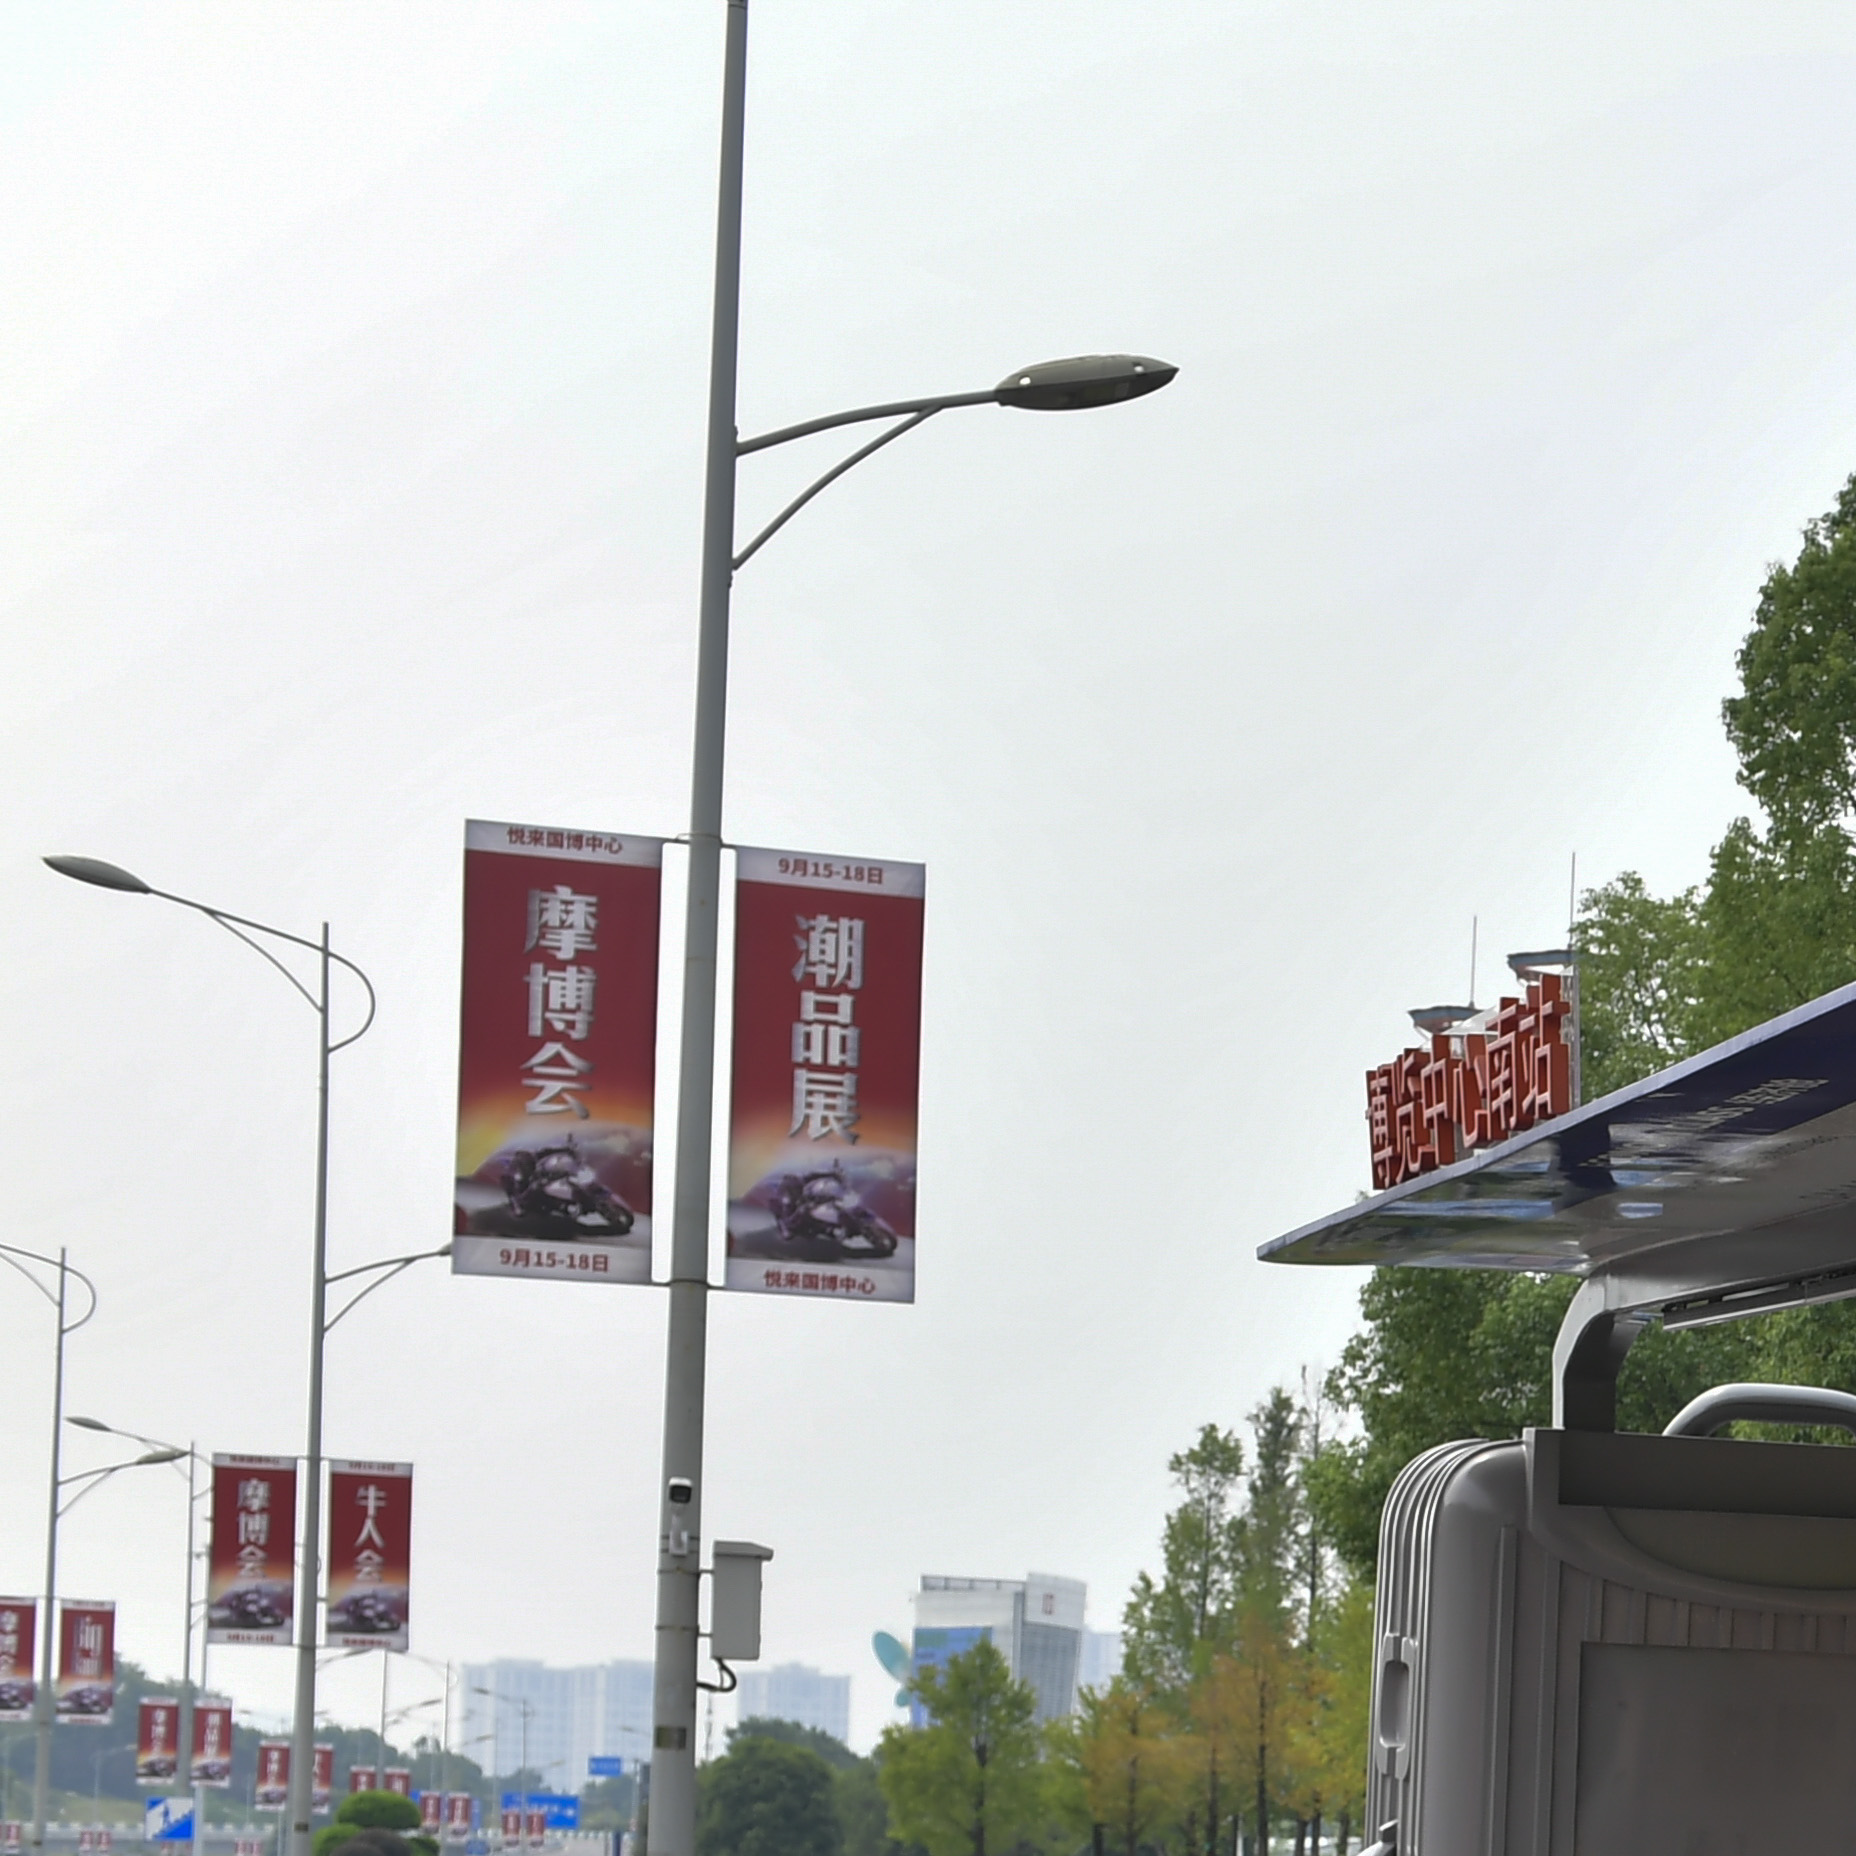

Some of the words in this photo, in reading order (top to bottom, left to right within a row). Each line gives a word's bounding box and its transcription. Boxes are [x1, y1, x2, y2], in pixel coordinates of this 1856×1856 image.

[507, 826, 623, 855] 悦来国博中心
[777, 857, 884, 885] 9月15-18日
[521, 884, 599, 1119] 摩博会
[788, 913, 865, 1146] 潮品展
[1366, 975, 1570, 1190] 博览中心南站
[498, 1247, 609, 1273] 9月15-18日
[763, 1268, 876, 1296] 悦来国博中心
[237, 1477, 271, 1579] 摩博会
[354, 1484, 387, 1583] 牛人会
